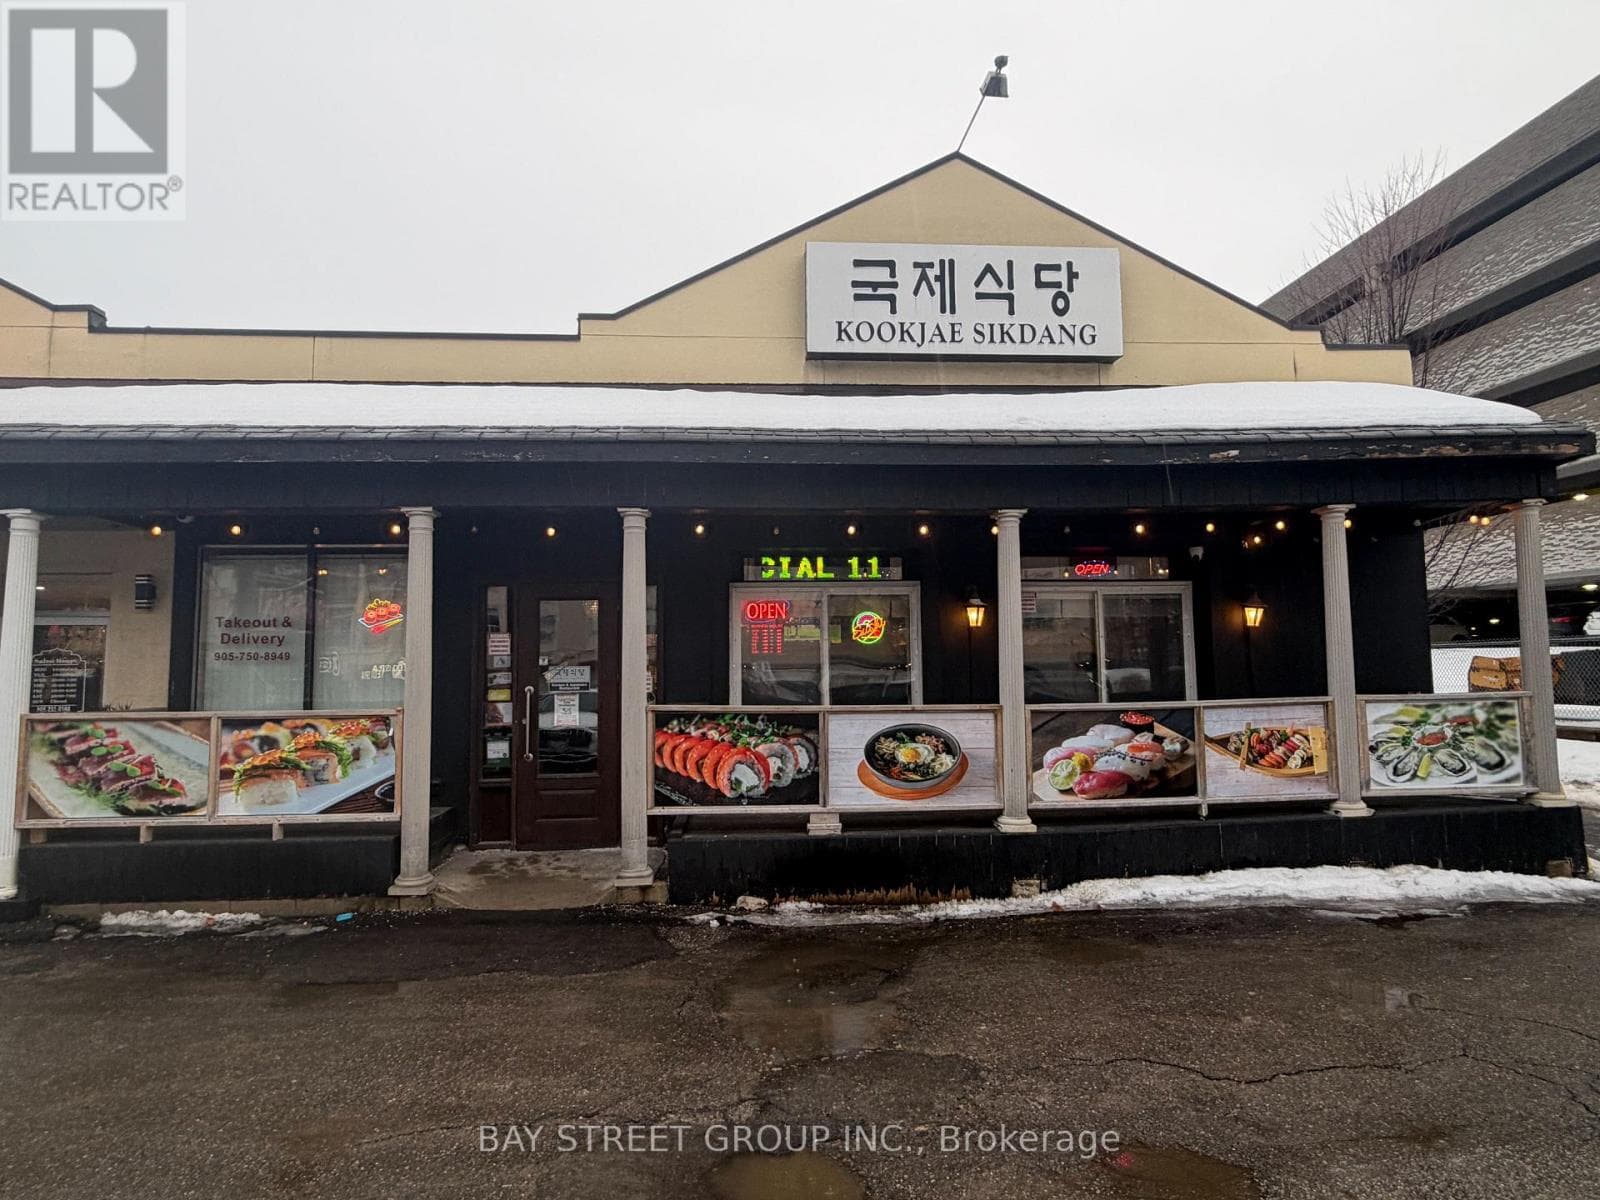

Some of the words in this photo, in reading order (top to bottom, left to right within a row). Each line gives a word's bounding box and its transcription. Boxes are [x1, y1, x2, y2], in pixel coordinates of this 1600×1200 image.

[851, 257, 1080, 317] 국제식당
[835, 320, 964, 347] KOOKJAE
[973, 323, 1098, 345] SIKDANG
[1074, 563, 1110, 576] OPEN
[746, 602, 786, 619] OPEN
[214, 616, 277, 628] Takeout
[282, 616, 292, 628] &
[221, 633, 285, 647] Delivery
[214, 651, 291, 661] 905-750-8949
